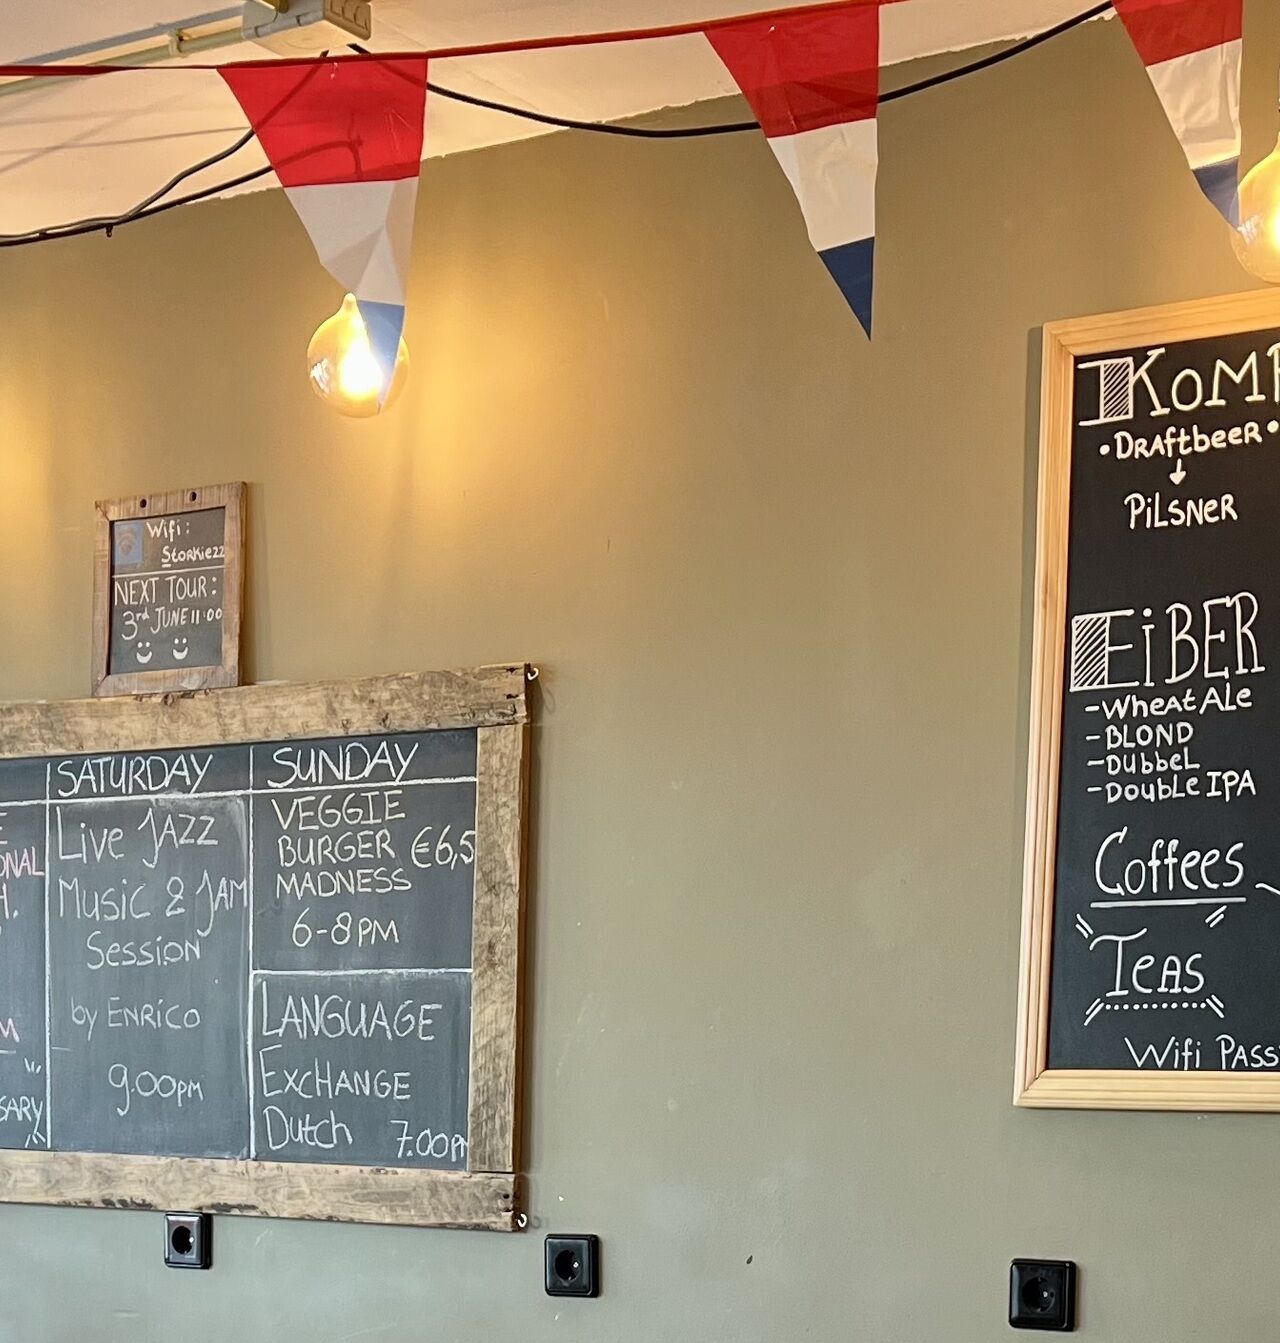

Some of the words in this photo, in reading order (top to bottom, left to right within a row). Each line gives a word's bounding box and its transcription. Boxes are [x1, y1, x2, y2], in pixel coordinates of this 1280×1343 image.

[115, 577, 159, 606] NEXT
[122, 606, 150, 640] 3rd
[150, 606, 189, 634] JUNE
[57, 754, 214, 796] SATURDAY
[267, 741, 419, 789] SUNDAY
[1206, 769, 1256, 802] IPA
[271, 790, 407, 831] VEGGIE
[57, 806, 125, 863] Live
[138, 808, 219, 868] JAZZ
[278, 831, 396, 866] BURGER
[1094, 826, 1244, 896] Coffees
[196, 870, 248, 936] JAM
[275, 868, 413, 900] MADNESS
[71, 999, 97, 1040] by
[261, 980, 443, 1040] LANGUAGE
[1124, 1036, 1201, 1071] Wifi
[263, 1105, 353, 1150] Dutch
